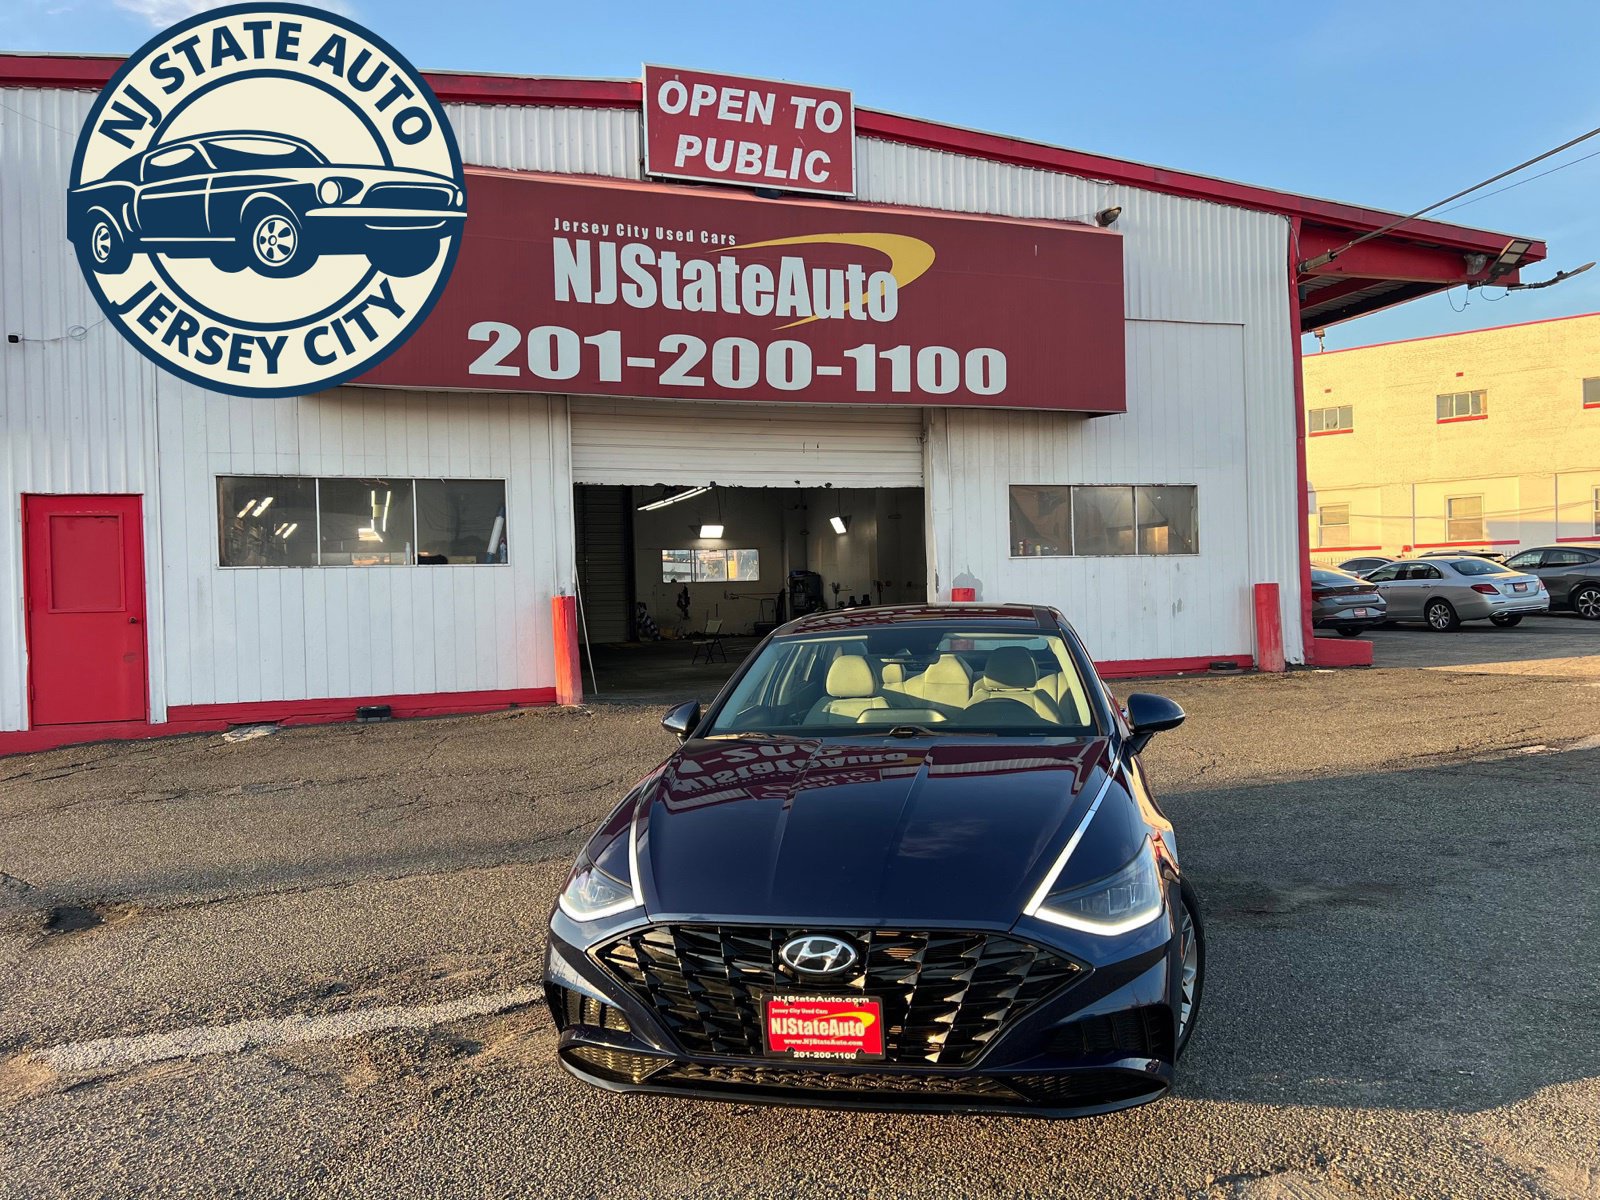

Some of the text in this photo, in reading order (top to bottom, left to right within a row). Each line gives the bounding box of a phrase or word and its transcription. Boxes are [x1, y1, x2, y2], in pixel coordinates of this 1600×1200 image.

[658, 80, 843, 134] OPEN TO
[675, 133, 831, 184] PUBLIC
[554, 217, 736, 246] Jersey City Used Cars
[553, 237, 899, 322] NJStateAuto
[467, 321, 1008, 396] 201-200-1100
[773, 995, 869, 1004] NJStateAuto.com
[771, 1017, 865, 1037] NJStateAuto
[793, 1051, 857, 1060] 201-200-1100
